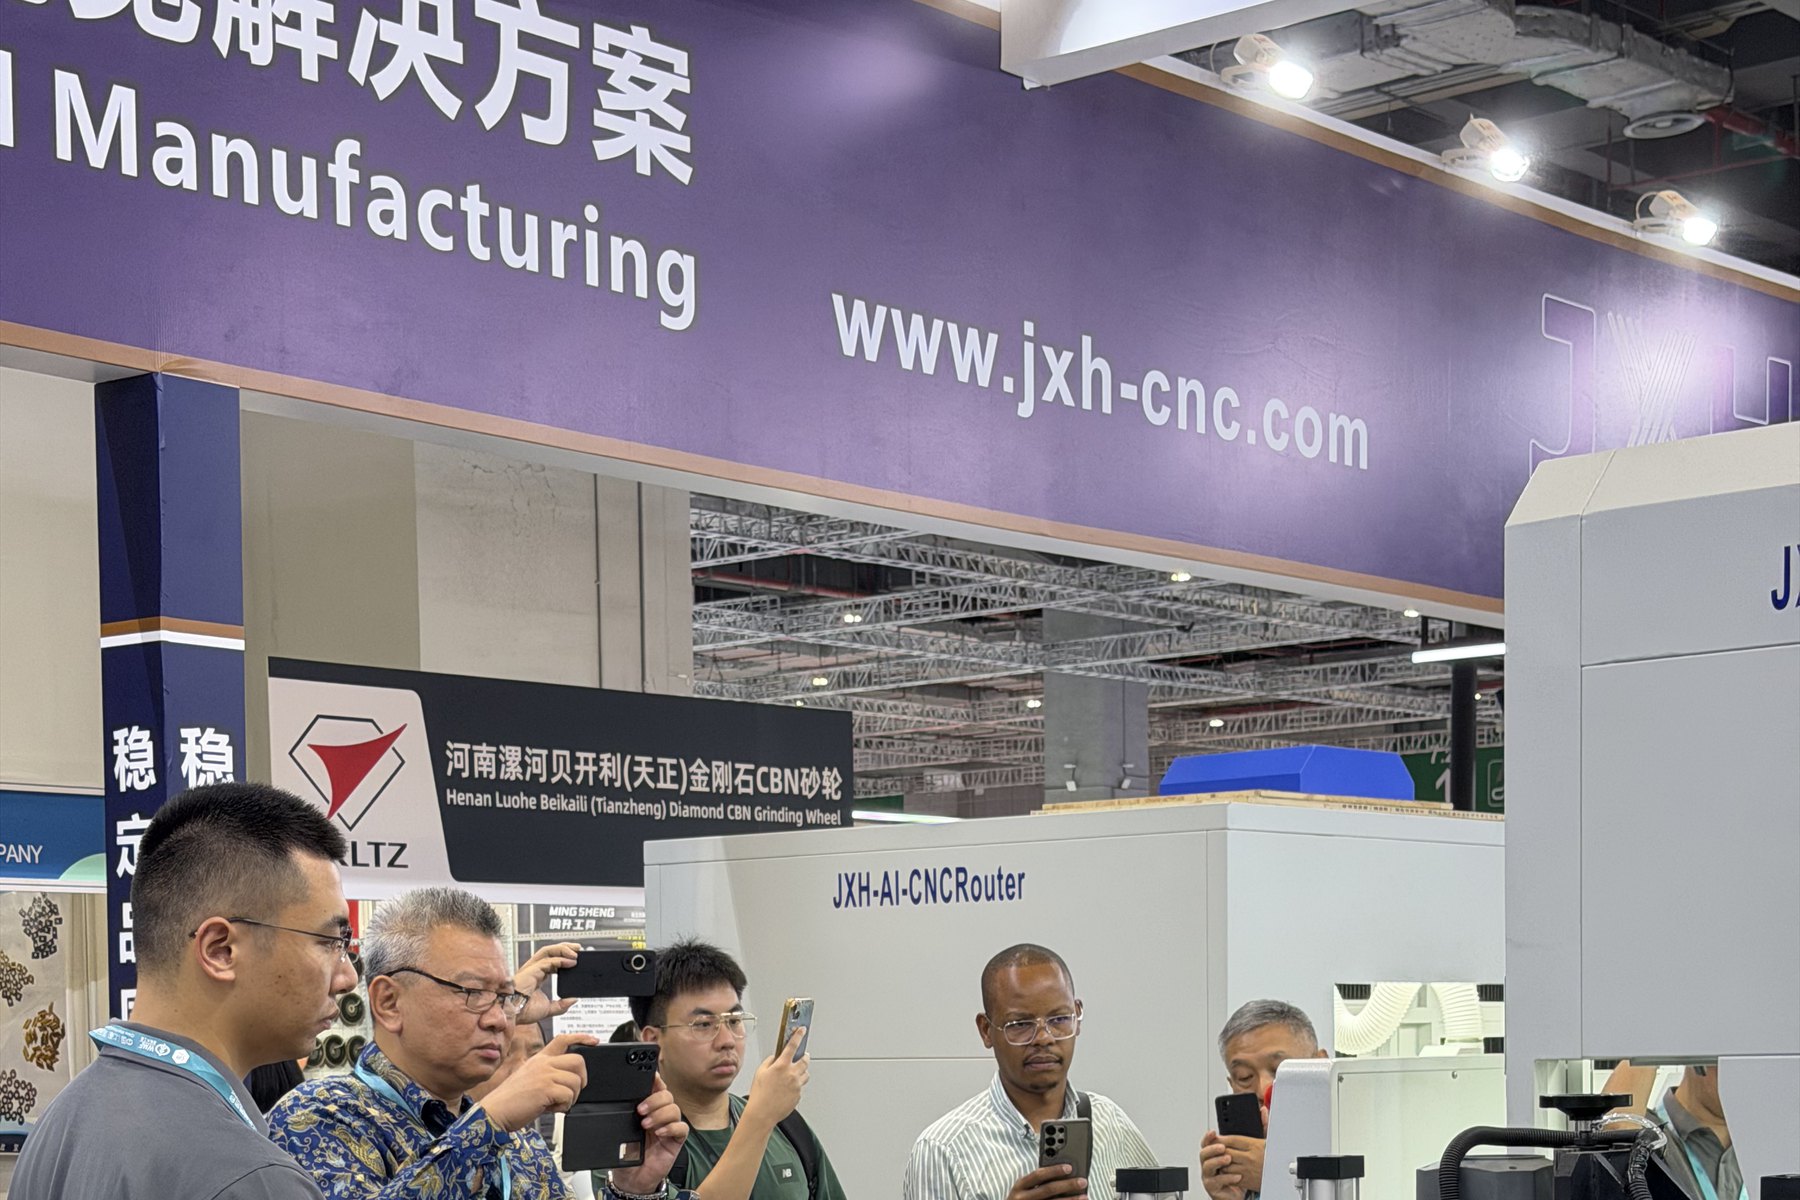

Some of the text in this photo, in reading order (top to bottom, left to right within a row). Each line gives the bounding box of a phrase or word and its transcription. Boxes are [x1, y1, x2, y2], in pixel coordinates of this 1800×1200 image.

[54, 69, 696, 331] Manufacturing
[831, 292, 1368, 471] www.jxh-cnc.com
[446, 740, 842, 801] 河南漯河贝开利(天正)金刚石CBN砂轮
[446, 788, 842, 827] Henan Luohe Beikaili (Tianzheng) Diamond CBN Grinding Wheel
[339, 841, 409, 869] LTZ
[833, 865, 1025, 909] JXH-AI-CNCRouter
